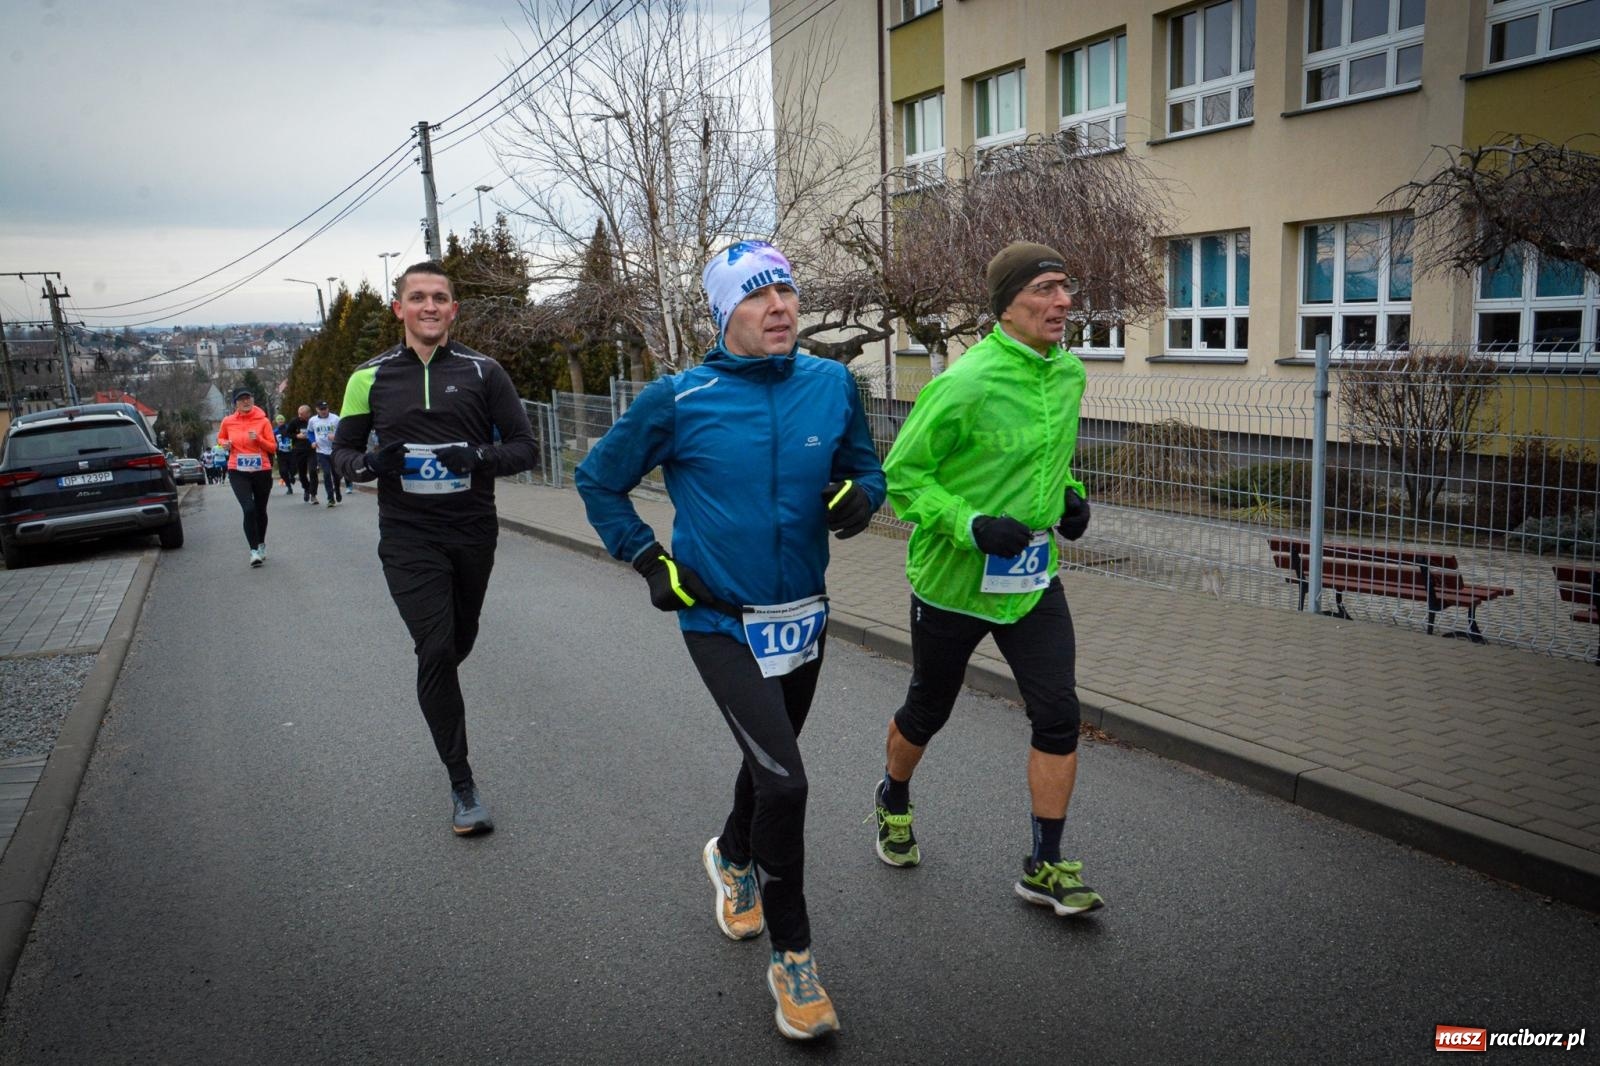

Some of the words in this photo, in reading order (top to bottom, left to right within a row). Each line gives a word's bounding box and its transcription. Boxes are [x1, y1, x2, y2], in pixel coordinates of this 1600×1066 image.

[240, 457, 258, 467] 172
[1007, 546, 1041, 574] 26
[761, 615, 816, 654] 107
